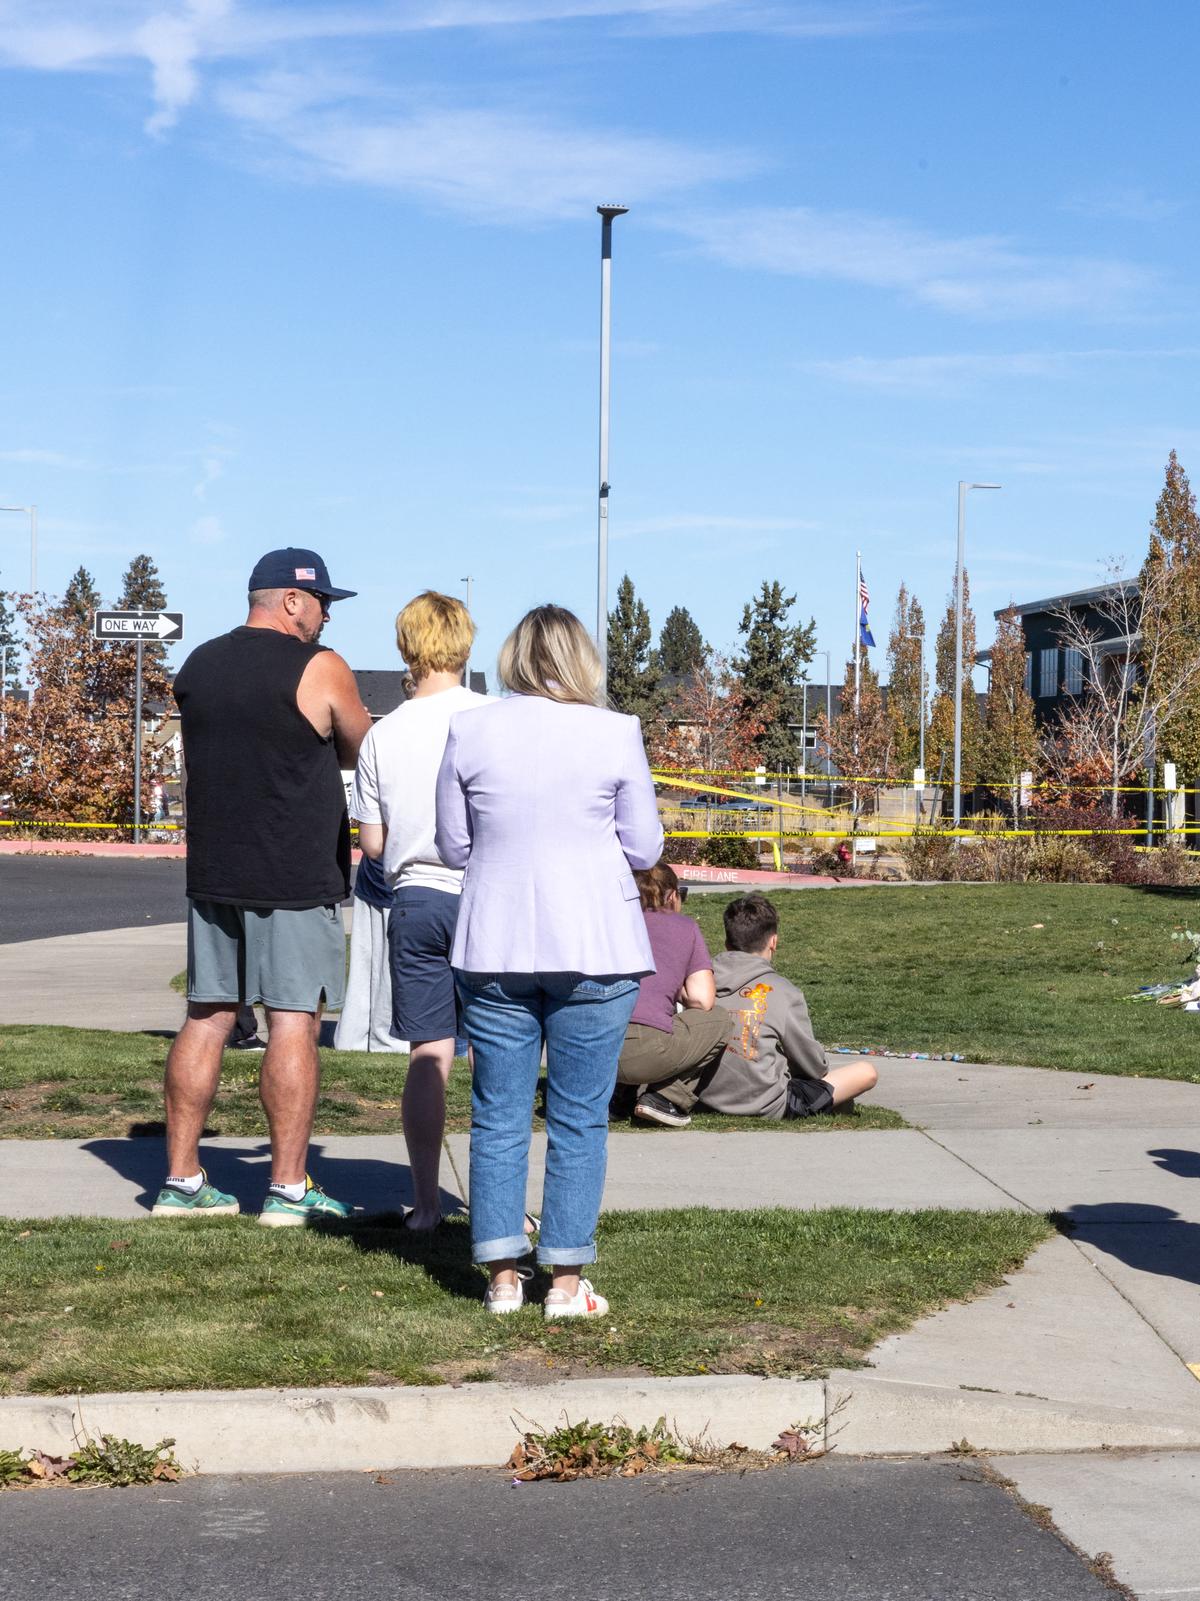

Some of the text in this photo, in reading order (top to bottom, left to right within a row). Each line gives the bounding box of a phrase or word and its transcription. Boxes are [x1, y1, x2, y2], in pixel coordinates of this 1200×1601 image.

[105, 620, 157, 631] ONE WAY
[683, 869, 738, 882] FIRE LANE
